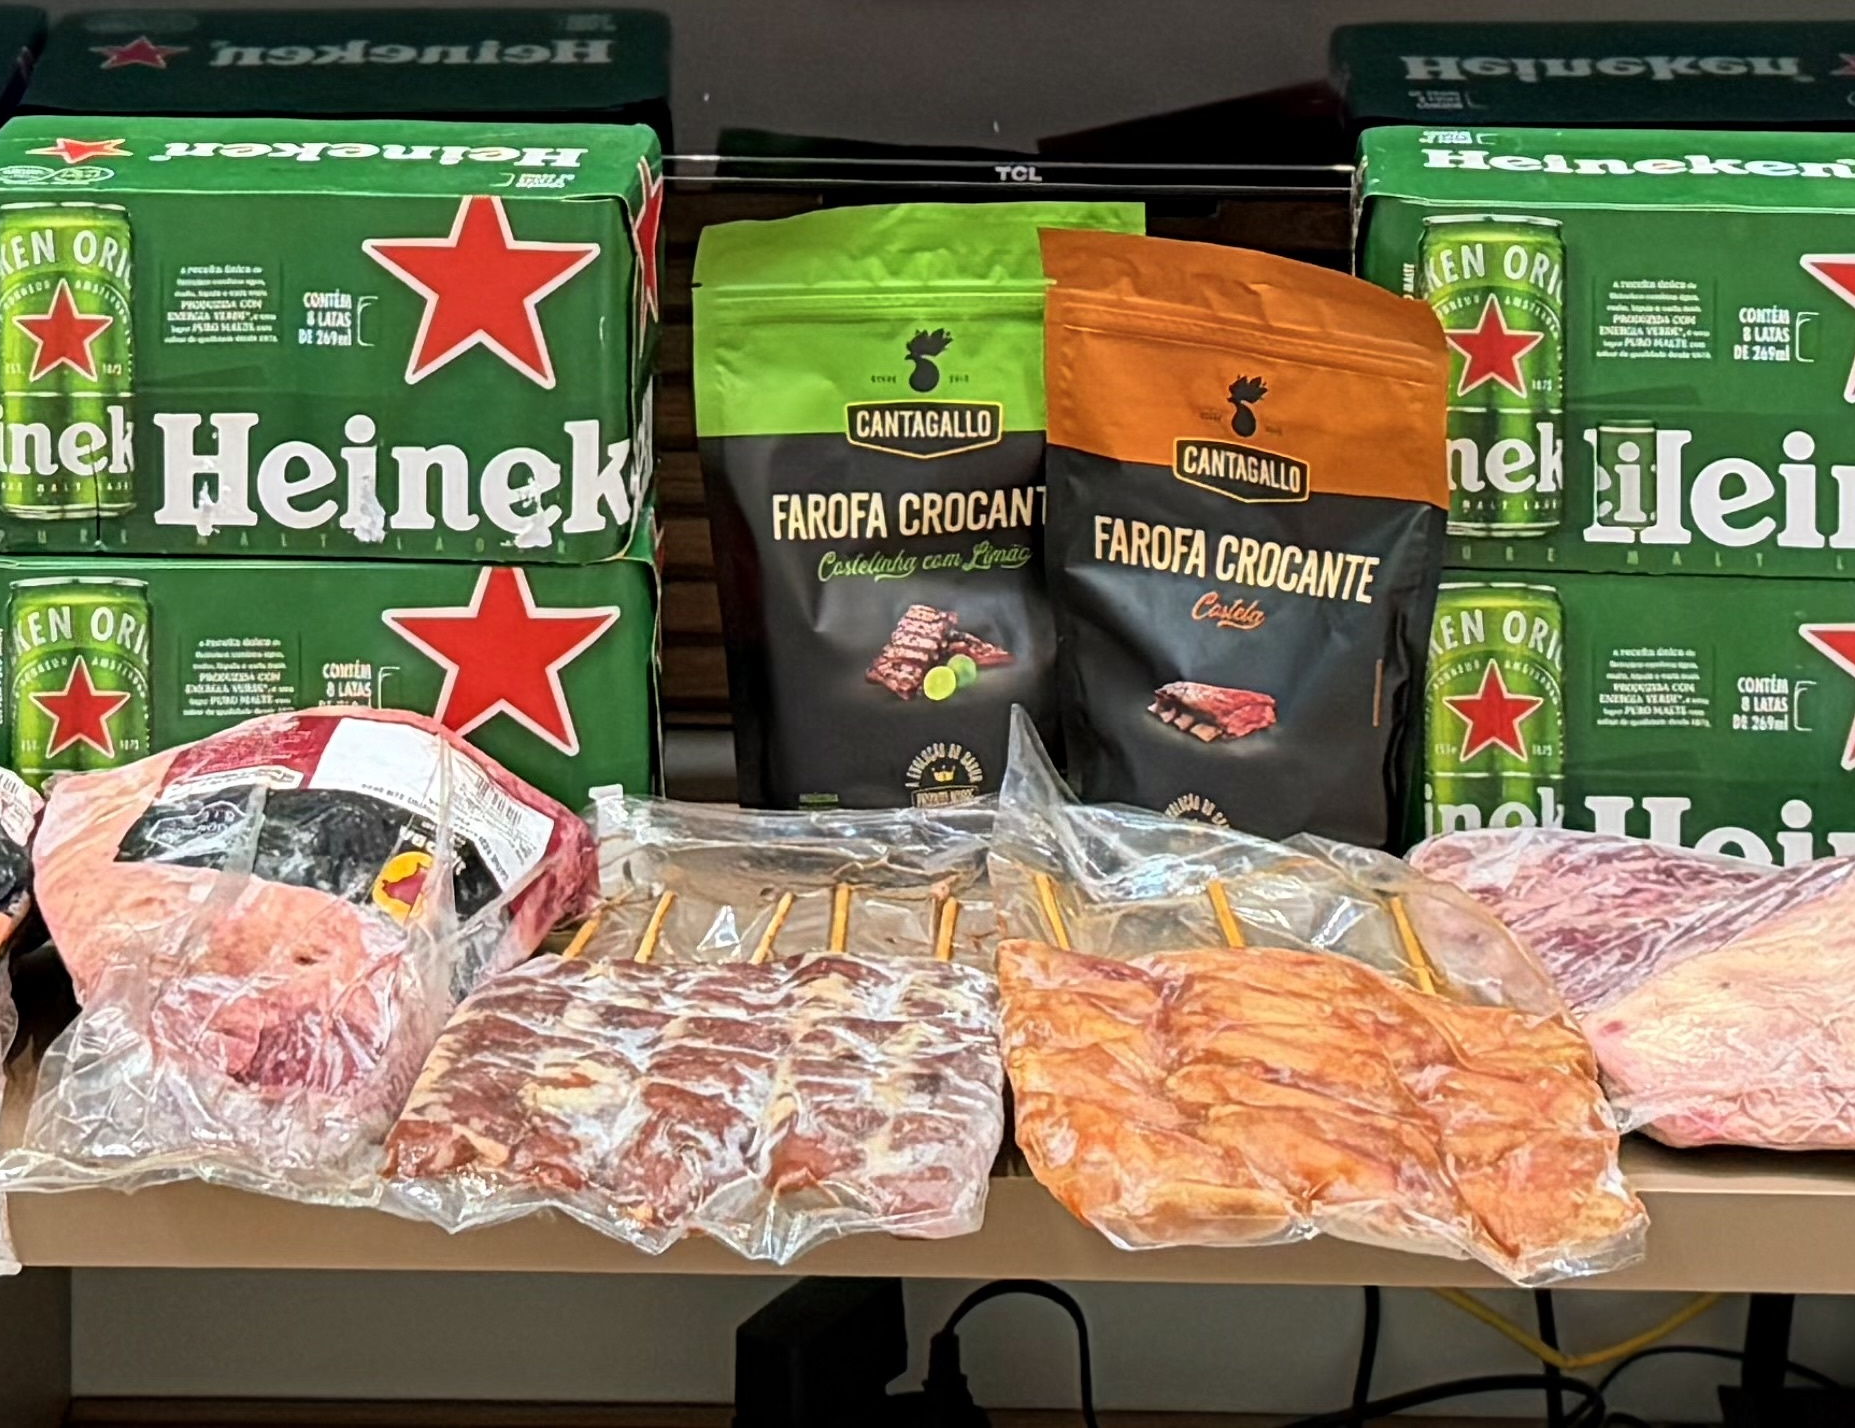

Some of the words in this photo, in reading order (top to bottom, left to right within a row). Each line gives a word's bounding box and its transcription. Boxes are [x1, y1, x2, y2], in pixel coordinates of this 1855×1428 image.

[162, 140, 588, 169] Heineken
[995, 165, 1042, 182] TCL
[1739, 305, 1791, 325] CONTÉM
[1743, 327, 1752, 342] 8
[1754, 327, 1791, 342] LATAS
[1733, 345, 1750, 360] DE
[1752, 345, 1791, 361] 269ml
[856, 410, 991, 438] CANTAGALLO
[152, 412, 632, 534] Heinek
[1183, 445, 1301, 493] CANTAGALLO
[772, 492, 888, 541] FAROFA
[962, 540, 1033, 571] Limão
[1094, 515, 1206, 578] FAROFA
[1215, 534, 1380, 604] CROCANTE
[322, 658, 372, 680] CONTÉM
[337, 681, 372, 697] LATAS
[1737, 674, 1789, 694] CONTÉM
[1753, 696, 1789, 712] LATAS
[1751, 714, 1789, 731] 269ml
